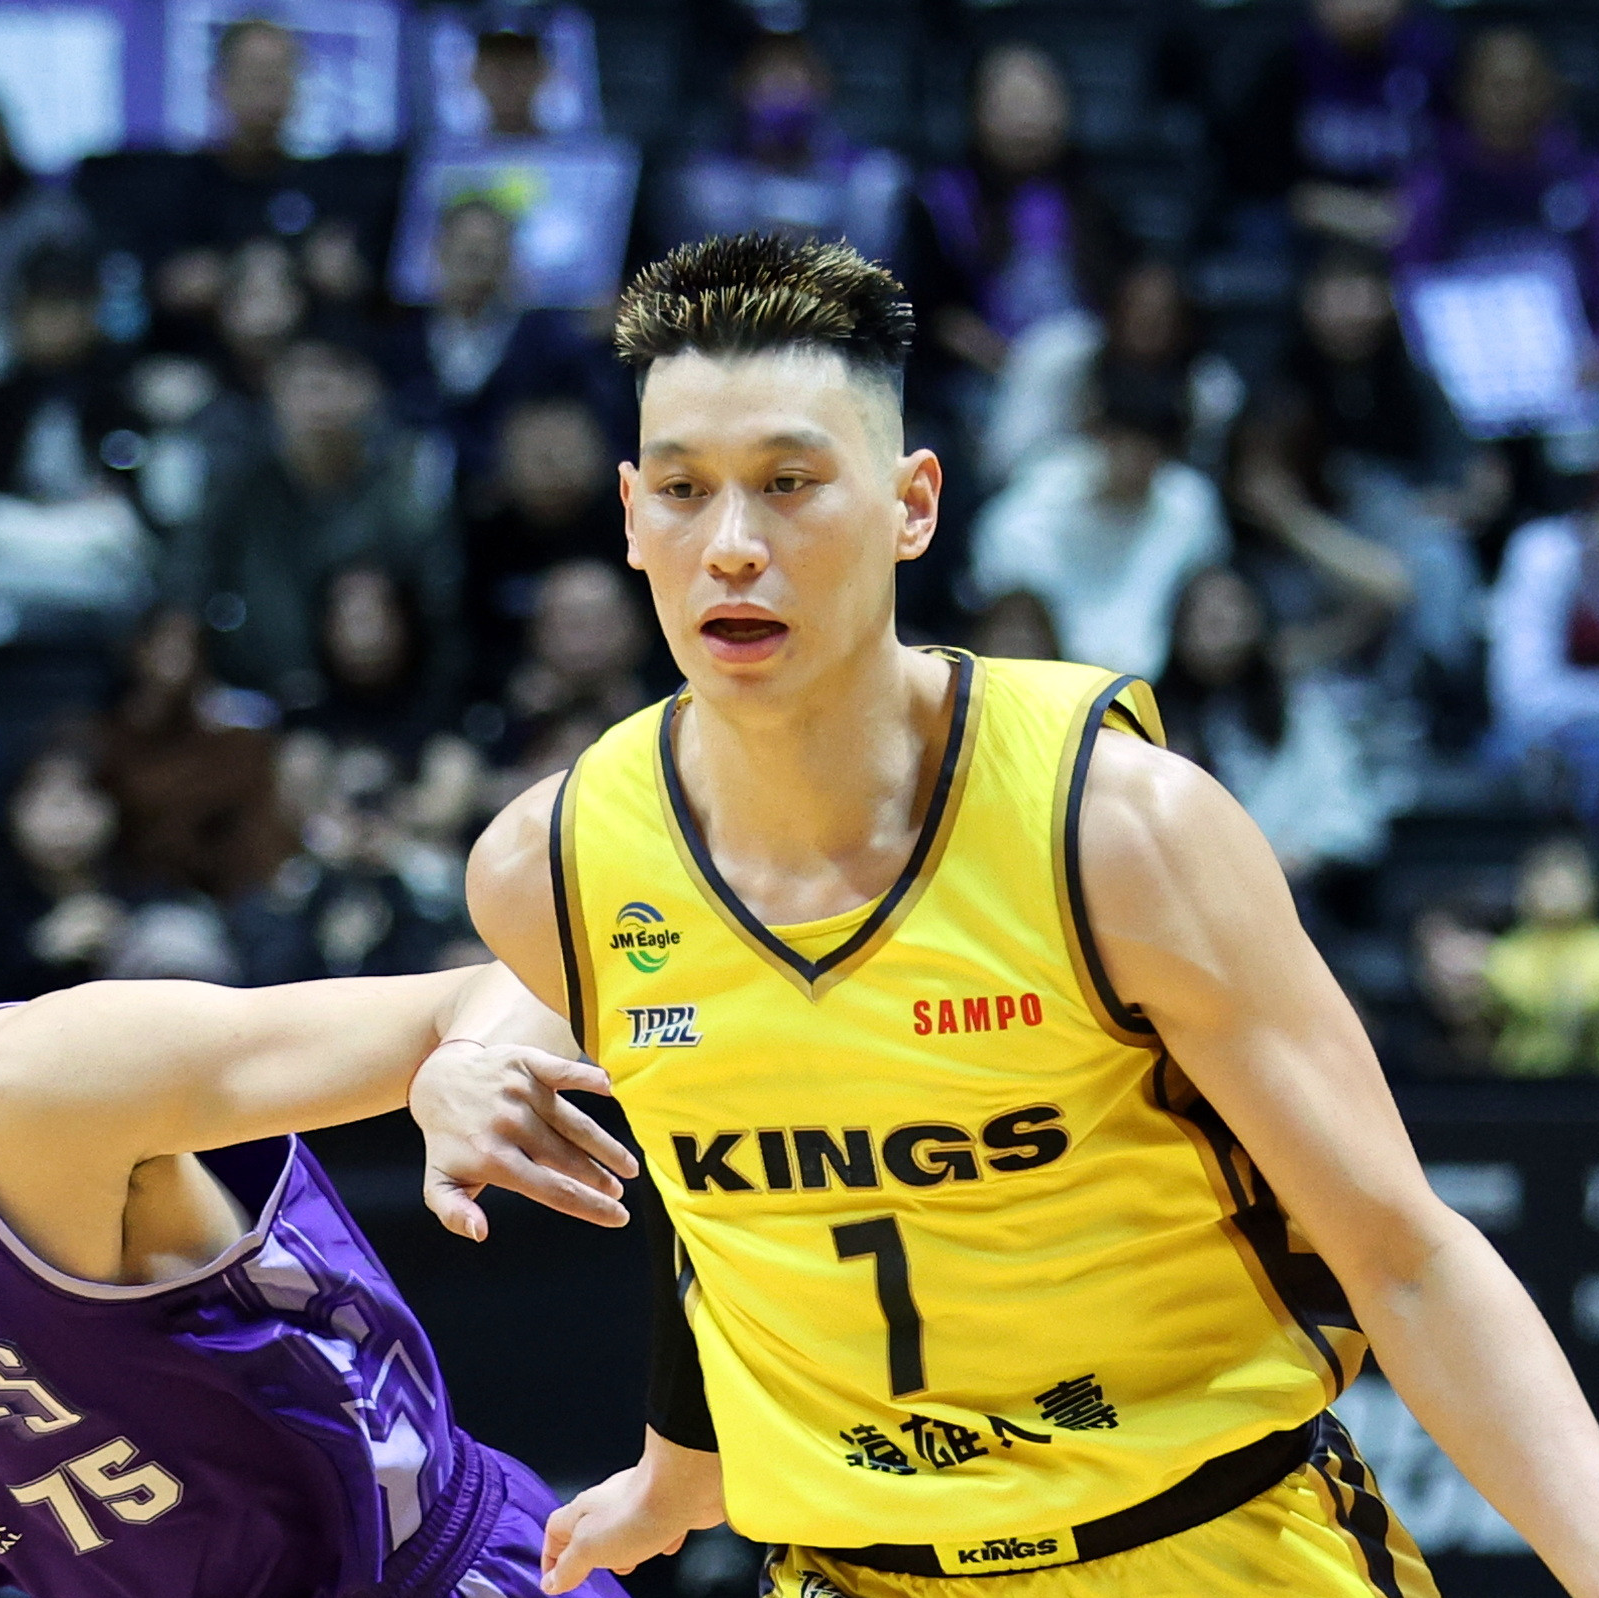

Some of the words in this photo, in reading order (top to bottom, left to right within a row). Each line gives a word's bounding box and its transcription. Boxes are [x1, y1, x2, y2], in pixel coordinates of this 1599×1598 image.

[609, 932, 635, 950] JM
[636, 929, 681, 949] Eagle
[616, 1003, 703, 1048] TPBL
[912, 992, 1043, 1036] SAMPO
[669, 1103, 1073, 1194] KINGS
[829, 1214, 928, 1401] 7
[957, 1537, 1059, 1565] KINGS
